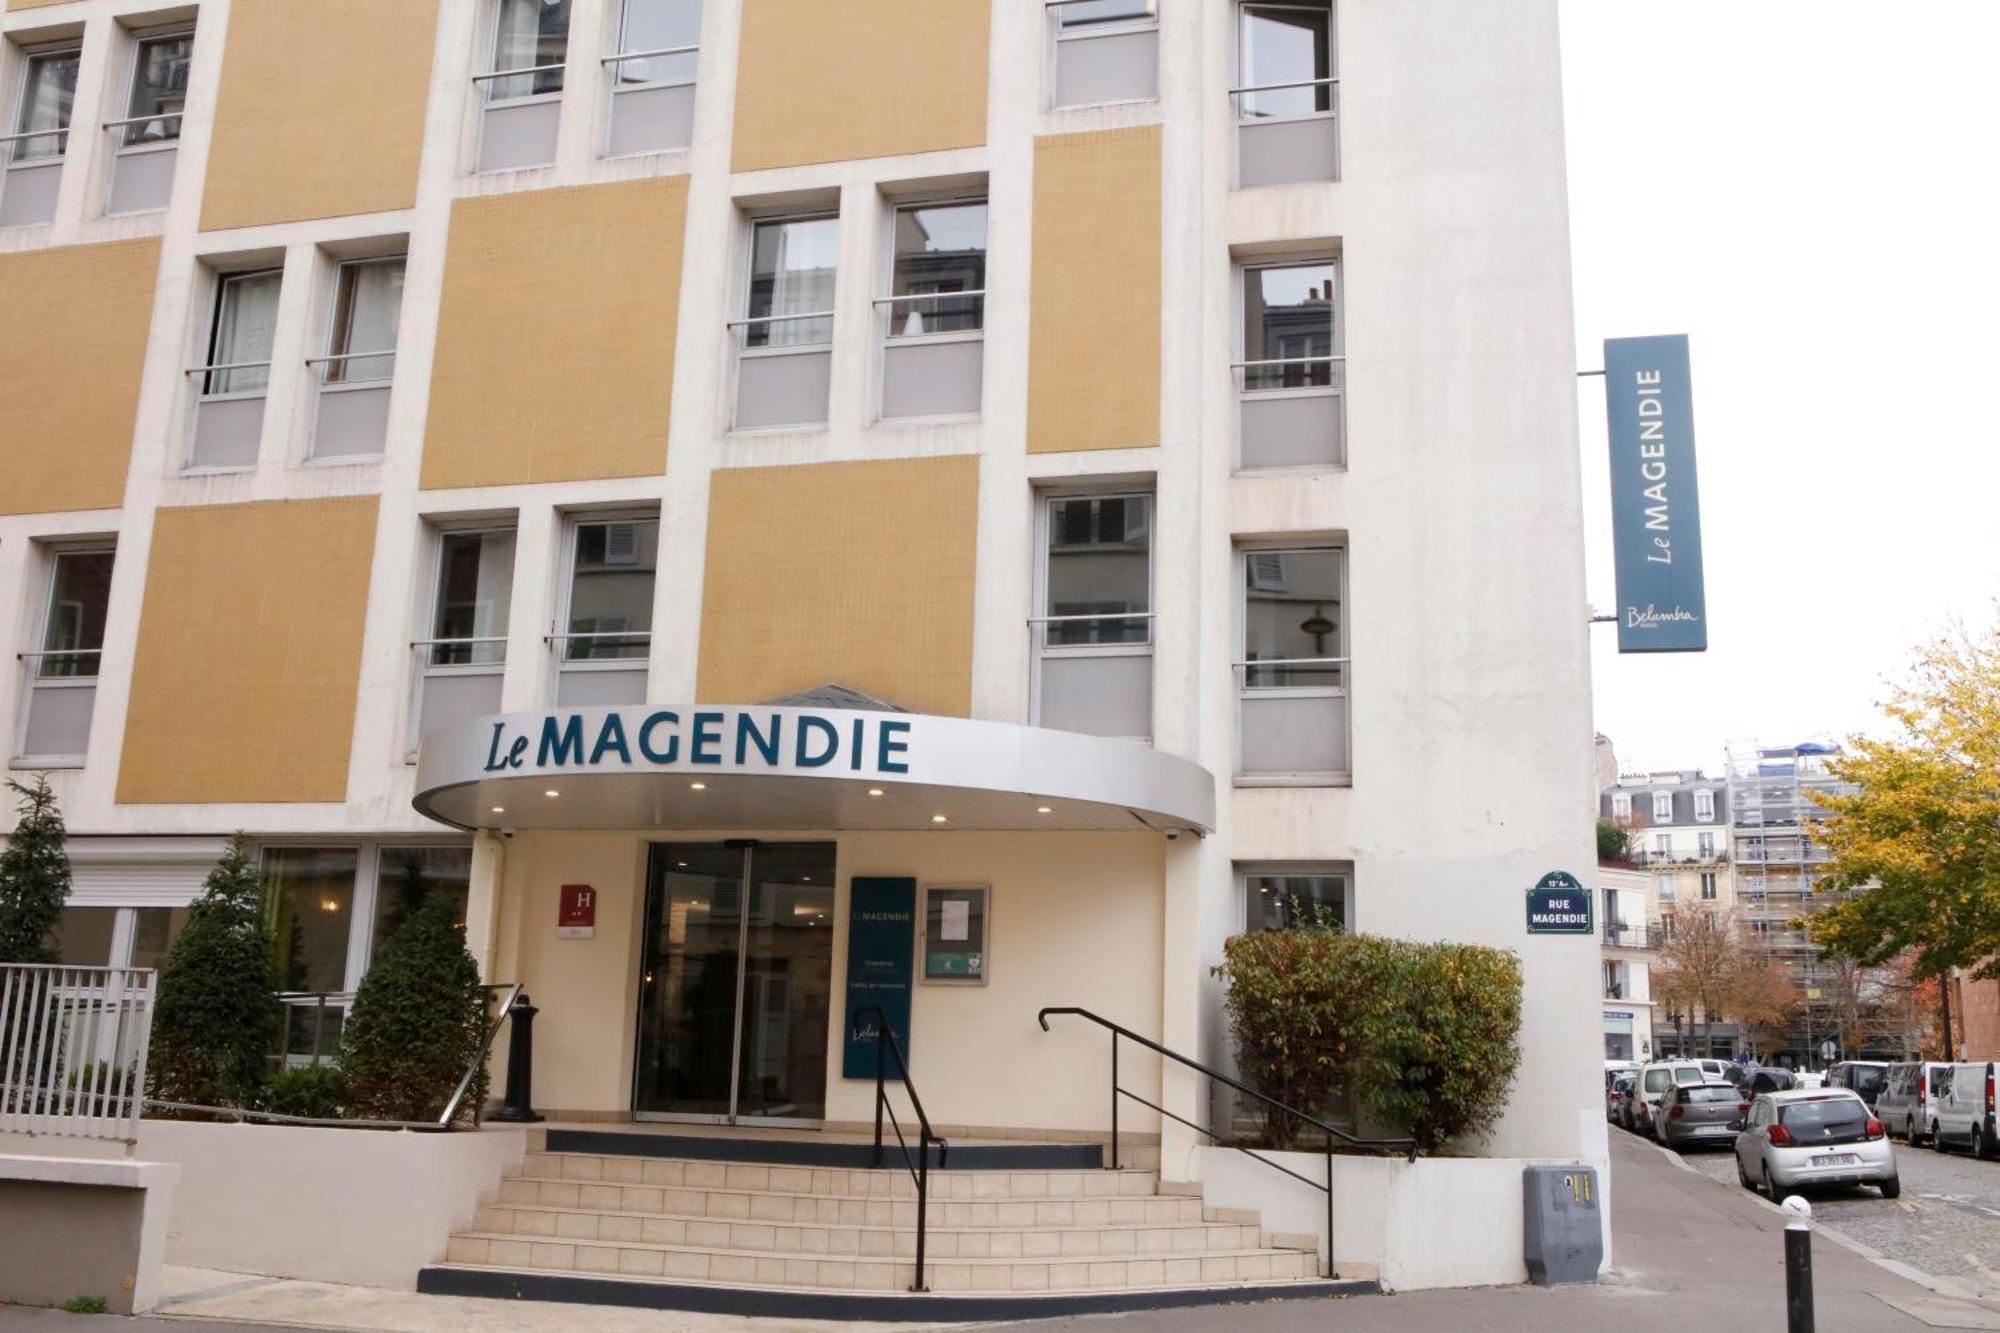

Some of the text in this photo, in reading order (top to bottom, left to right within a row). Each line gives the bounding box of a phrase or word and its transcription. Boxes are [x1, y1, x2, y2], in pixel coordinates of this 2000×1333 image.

[1636, 369, 1671, 564] Le MAGENDIE
[1627, 603, 1698, 628] Belambra
[484, 710, 911, 774] Le MAGENDIE
[577, 892, 590, 907] H
[1548, 899, 1570, 909] RUE
[1532, 913, 1588, 923] MAGENDIE
